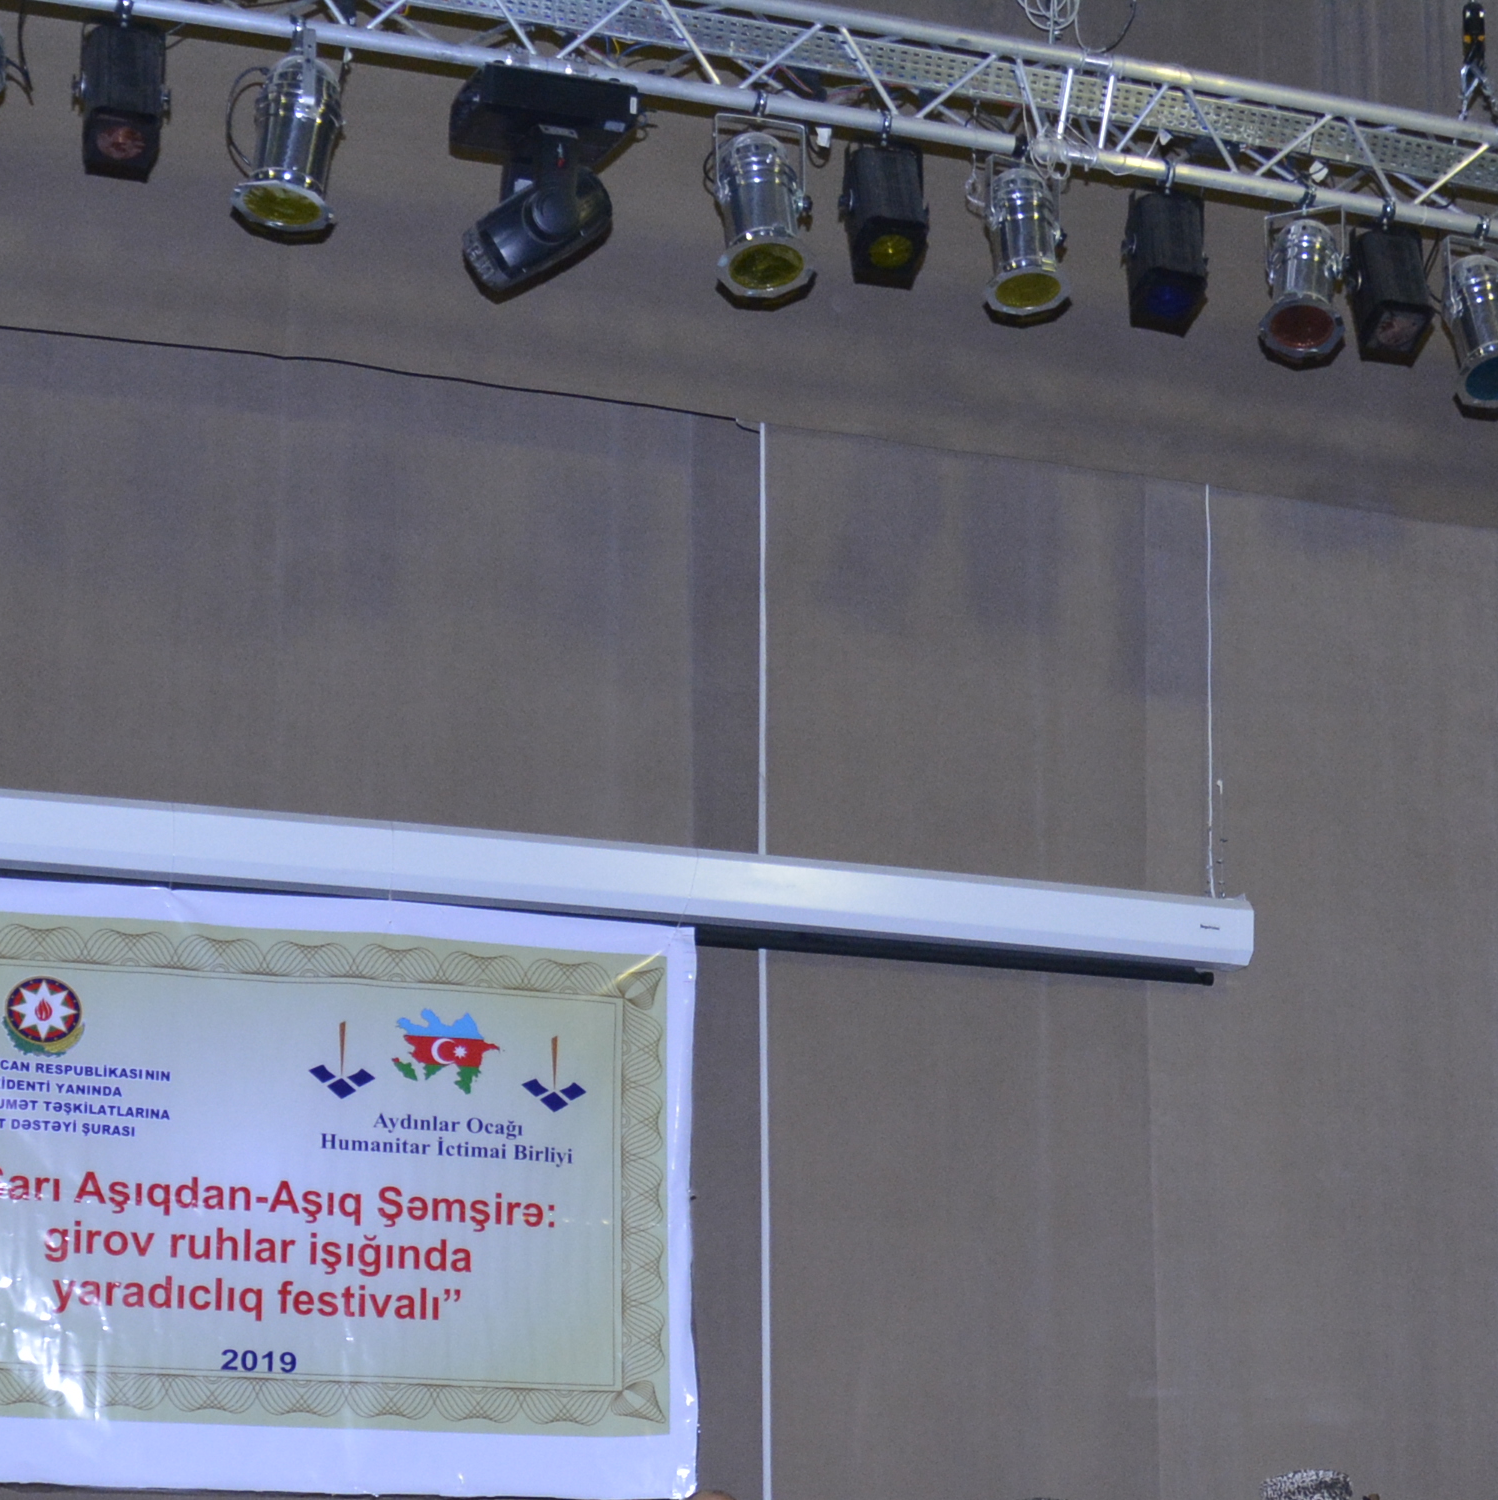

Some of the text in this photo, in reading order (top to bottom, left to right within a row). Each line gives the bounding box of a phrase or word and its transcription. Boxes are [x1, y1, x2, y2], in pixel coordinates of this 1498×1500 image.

[55, 1083, 123, 1098] YANINDA
[43, 1100, 171, 1120] TƏŞKİLATLARINA
[10, 1118, 77, 1133] DƏSTƏYİ
[81, 1122, 136, 1137] ŞURASI
[373, 1112, 524, 1140] Aydınlar Ocağı
[320, 1132, 573, 1168] Humanitar İctimai Birliyi
[73, 1171, 362, 1226] Aşıqdan-Aşıq
[377, 1186, 556, 1232] Şəmşirə:
[44, 1220, 472, 1277] girov ruhlar işığında
[52, 1275, 462, 1321] yaradıclıq festivalı”
[220, 1348, 298, 1373] 2019
